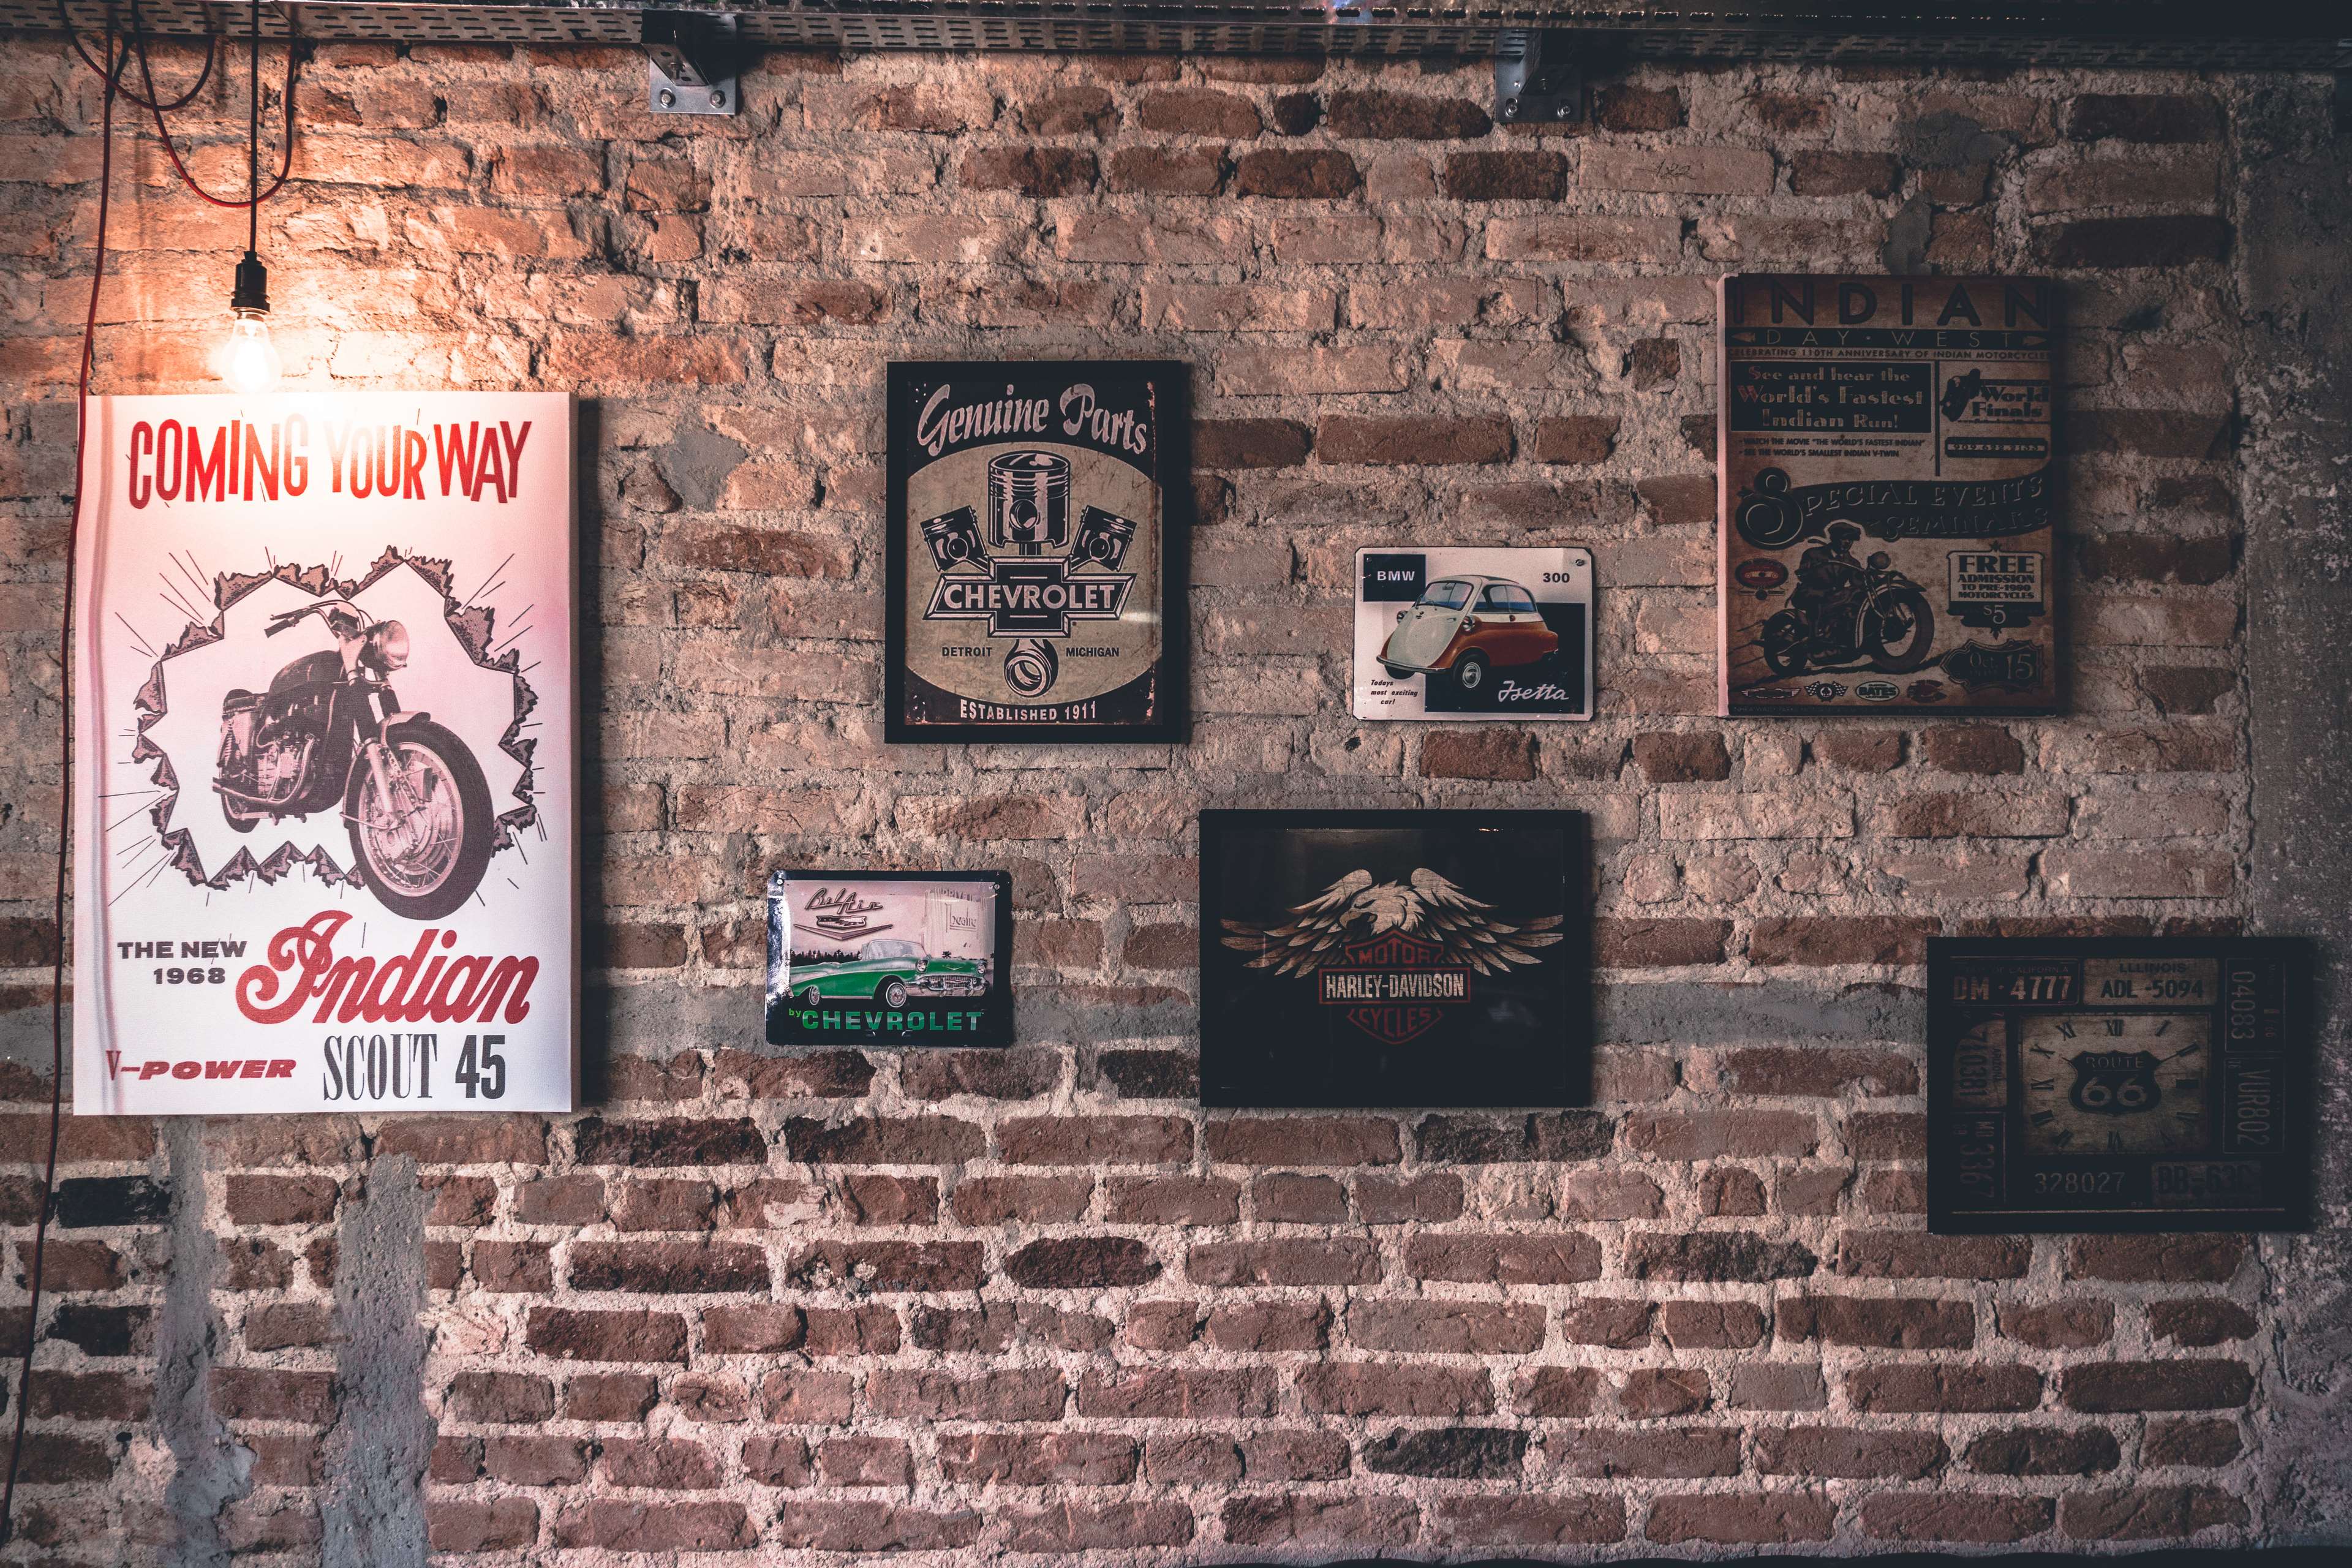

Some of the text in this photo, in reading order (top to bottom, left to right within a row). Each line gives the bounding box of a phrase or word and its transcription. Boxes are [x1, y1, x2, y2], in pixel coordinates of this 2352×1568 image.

[1733, 282, 2048, 329] INDIAN
[1767, 330, 2011, 347] DAY WEST
[1976, 351, 2051, 360] MOTORCYCLES
[1748, 366, 1911, 382] See and hear the
[1737, 385, 1924, 405] World's Fastest
[1980, 386, 2049, 402] World
[917, 383, 1147, 456] Genuine Parts
[1762, 409, 1899, 429] Indian Run!
[1972, 402, 2042, 417] Finals
[129, 413, 532, 509] COMING YOUR WAY
[1959, 556, 2034, 573] FREE
[1377, 571, 1415, 581] BMW
[1543, 573, 1570, 583] 300
[1958, 575, 2035, 583] ADMISSION
[944, 584, 1115, 609] CHEVROLET
[942, 647, 1120, 657] DETROIT MICHIGAN
[2007, 653, 2035, 679] 15
[1498, 680, 1570, 703] Isetta
[1858, 687, 1896, 696] BATES
[960, 699, 1096, 721] ESTABLISHED 1911
[117, 940, 247, 959] THE NEW
[1359, 938, 1430, 965] MOTOR
[153, 967, 226, 985] 1968
[235, 910, 540, 1024] Indian
[1326, 973, 1464, 998] HARLEY-DAVIDSON
[1953, 975, 2073, 1000] DM 4777
[2101, 980, 2138, 998] ADL
[2231, 971, 2256, 1039] 04083
[788, 1008, 982, 1031] by CHEVROLET
[1359, 1008, 1431, 1039] CYCLES
[323, 1033, 507, 1101] SCOUT 45
[2085, 1056, 2144, 1069] ROUTE
[2081, 1074, 2147, 1107] 66
[2237, 1069, 2271, 1145] VUR802
[2034, 1172, 2125, 1194] 328027
